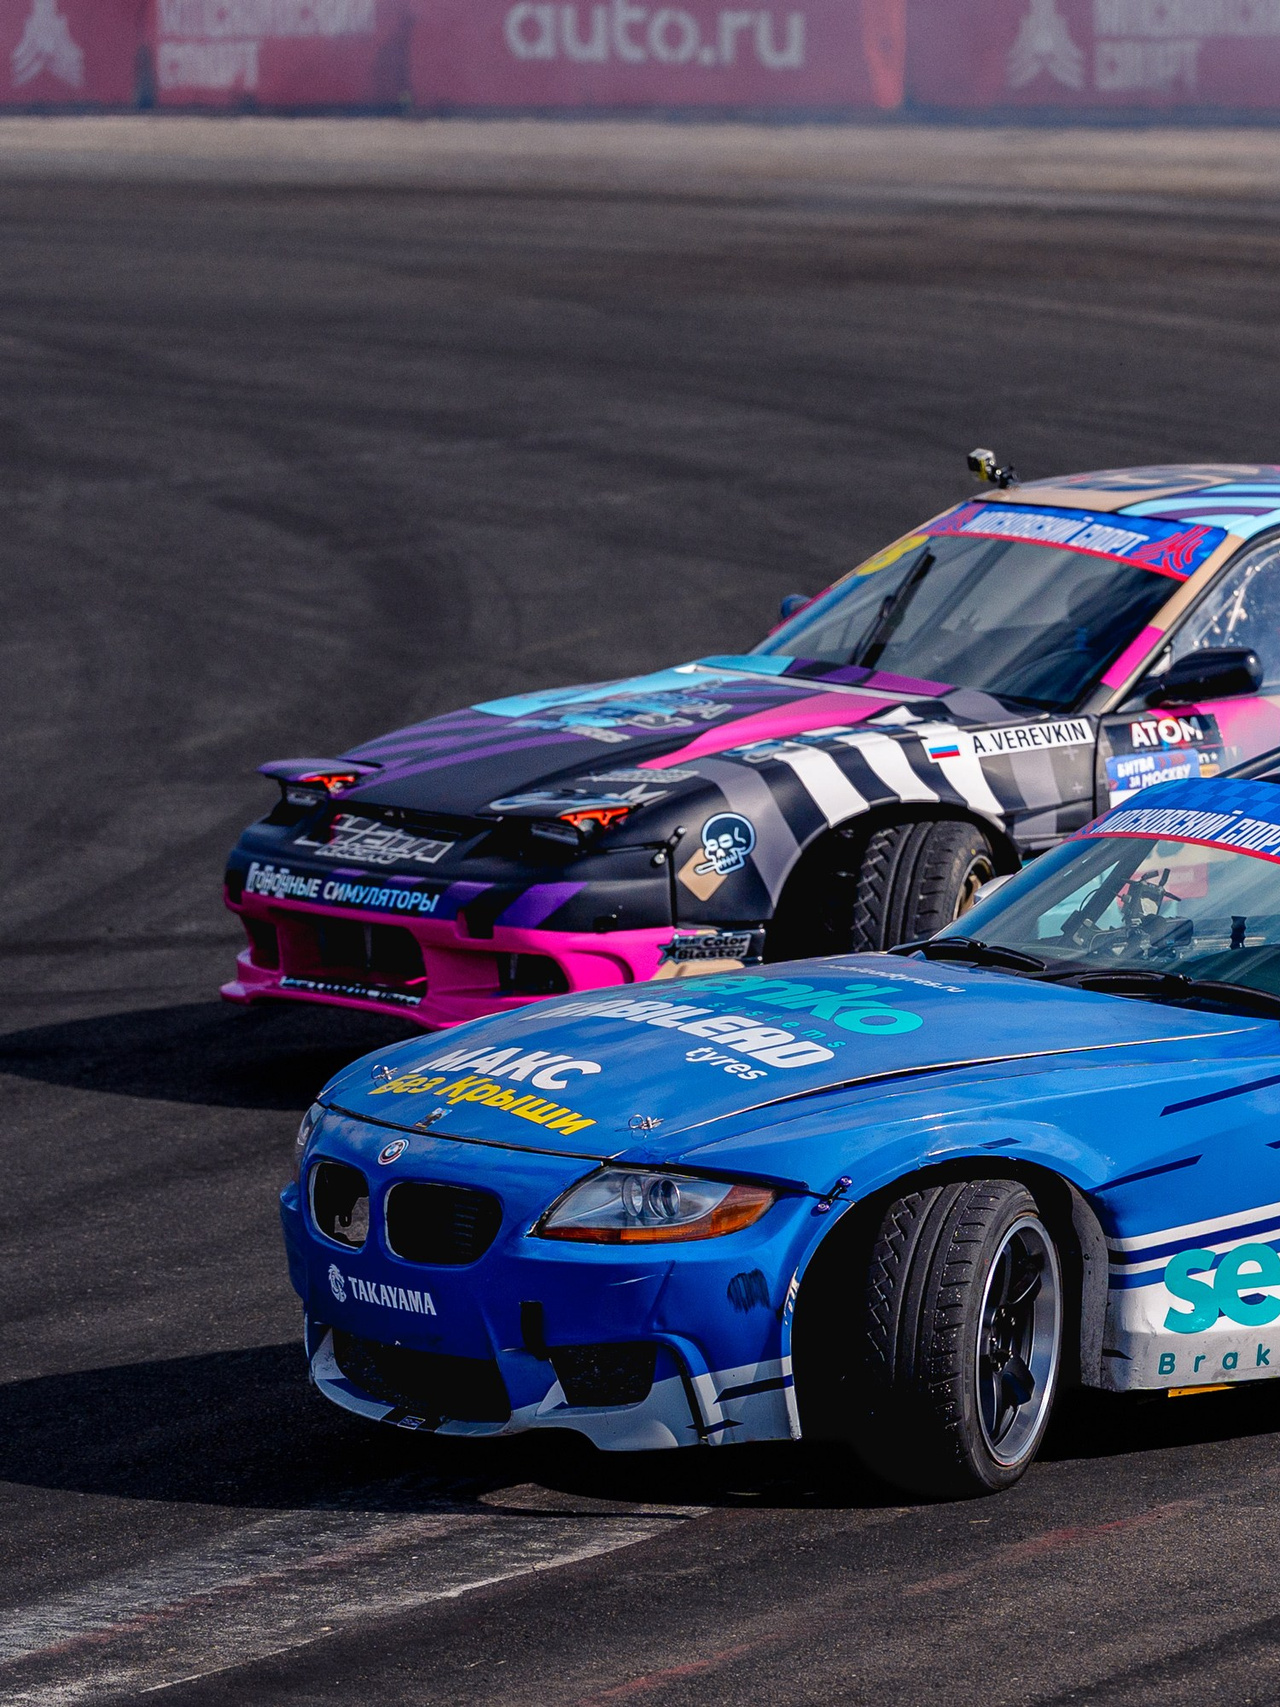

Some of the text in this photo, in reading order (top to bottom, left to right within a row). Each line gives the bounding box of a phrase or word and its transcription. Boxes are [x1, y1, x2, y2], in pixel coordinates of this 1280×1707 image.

[503, 0, 803, 68] auto.ru
[1117, 757, 1155, 778] БИТВА
[323, 881, 440, 913] СИМУЛЯТОРЫ
[677, 948, 745, 960] Blaster
[703, 936, 746, 948] Color
[708, 1001, 846, 1049] systems
[408, 1046, 602, 1091] МАКС
[685, 1047, 768, 1081] tyres
[433, 1074, 598, 1136] Крыши
[347, 1275, 438, 1316] TAKAYAMA
